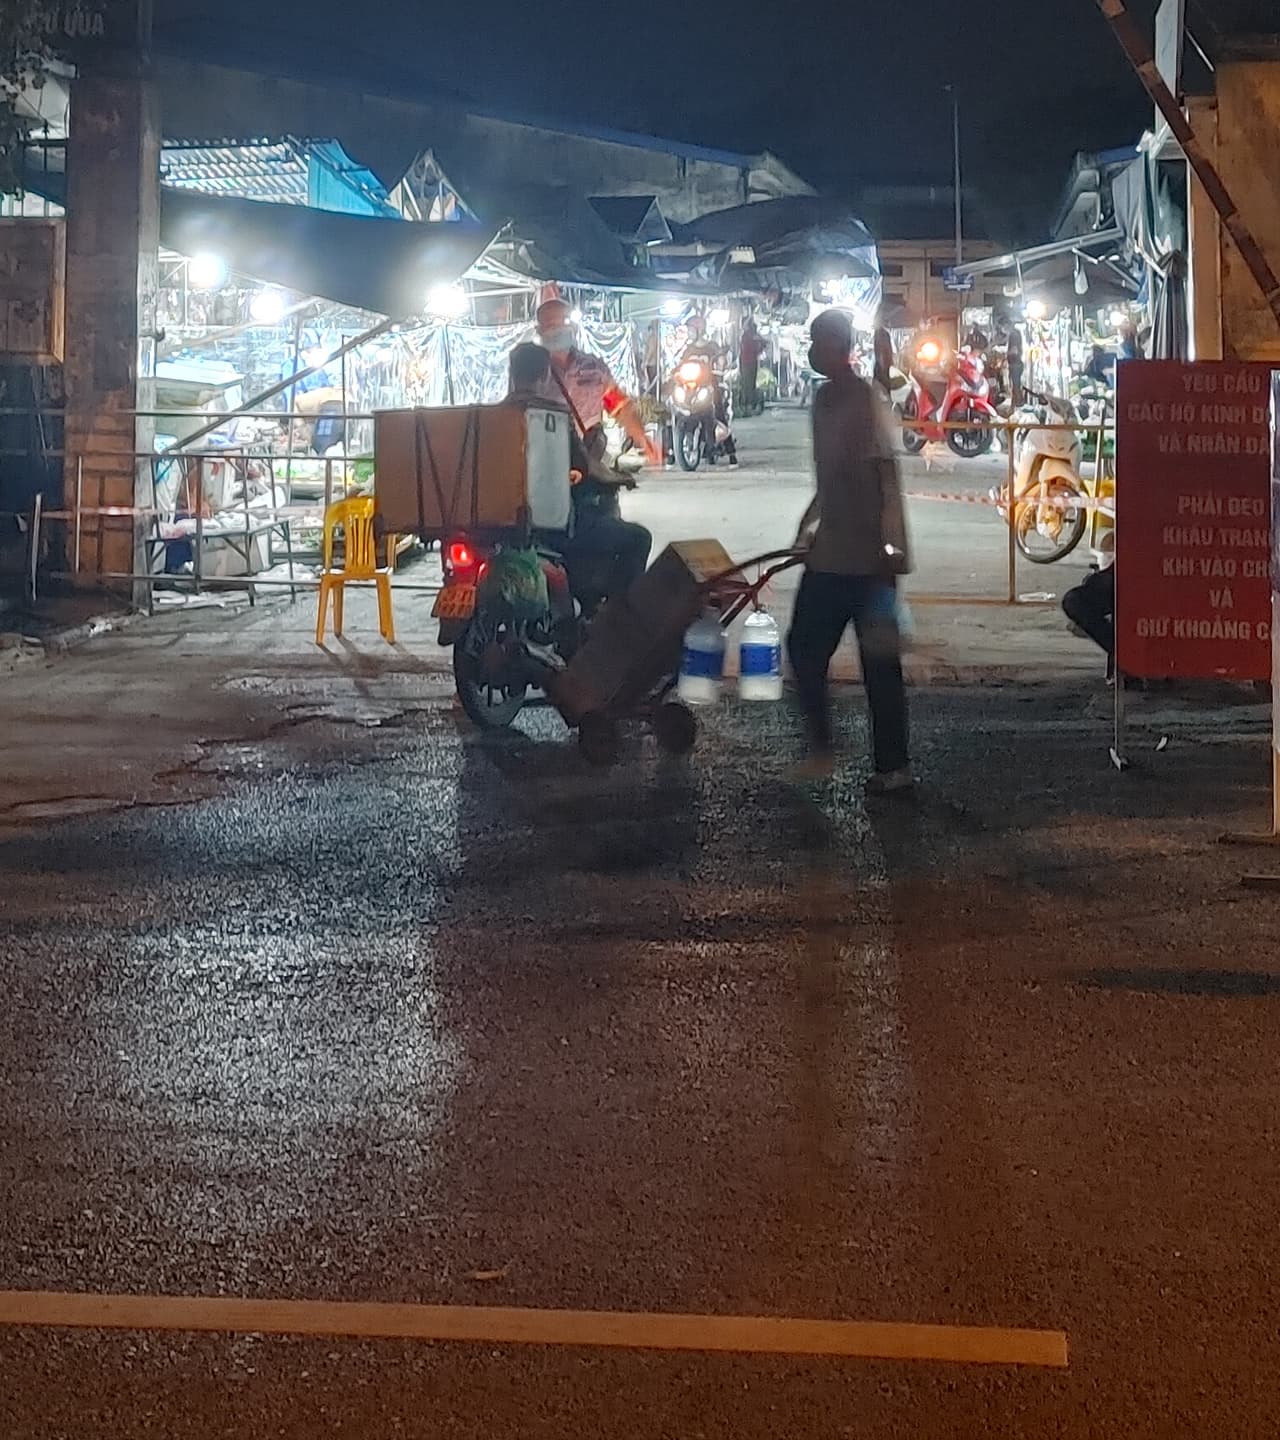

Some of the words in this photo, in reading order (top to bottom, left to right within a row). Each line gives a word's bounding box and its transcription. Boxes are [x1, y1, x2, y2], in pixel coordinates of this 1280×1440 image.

[1202, 404, 1246, 424] KINH
[1221, 527, 1271, 547] TRAN
[1162, 558, 1194, 577] KHI
